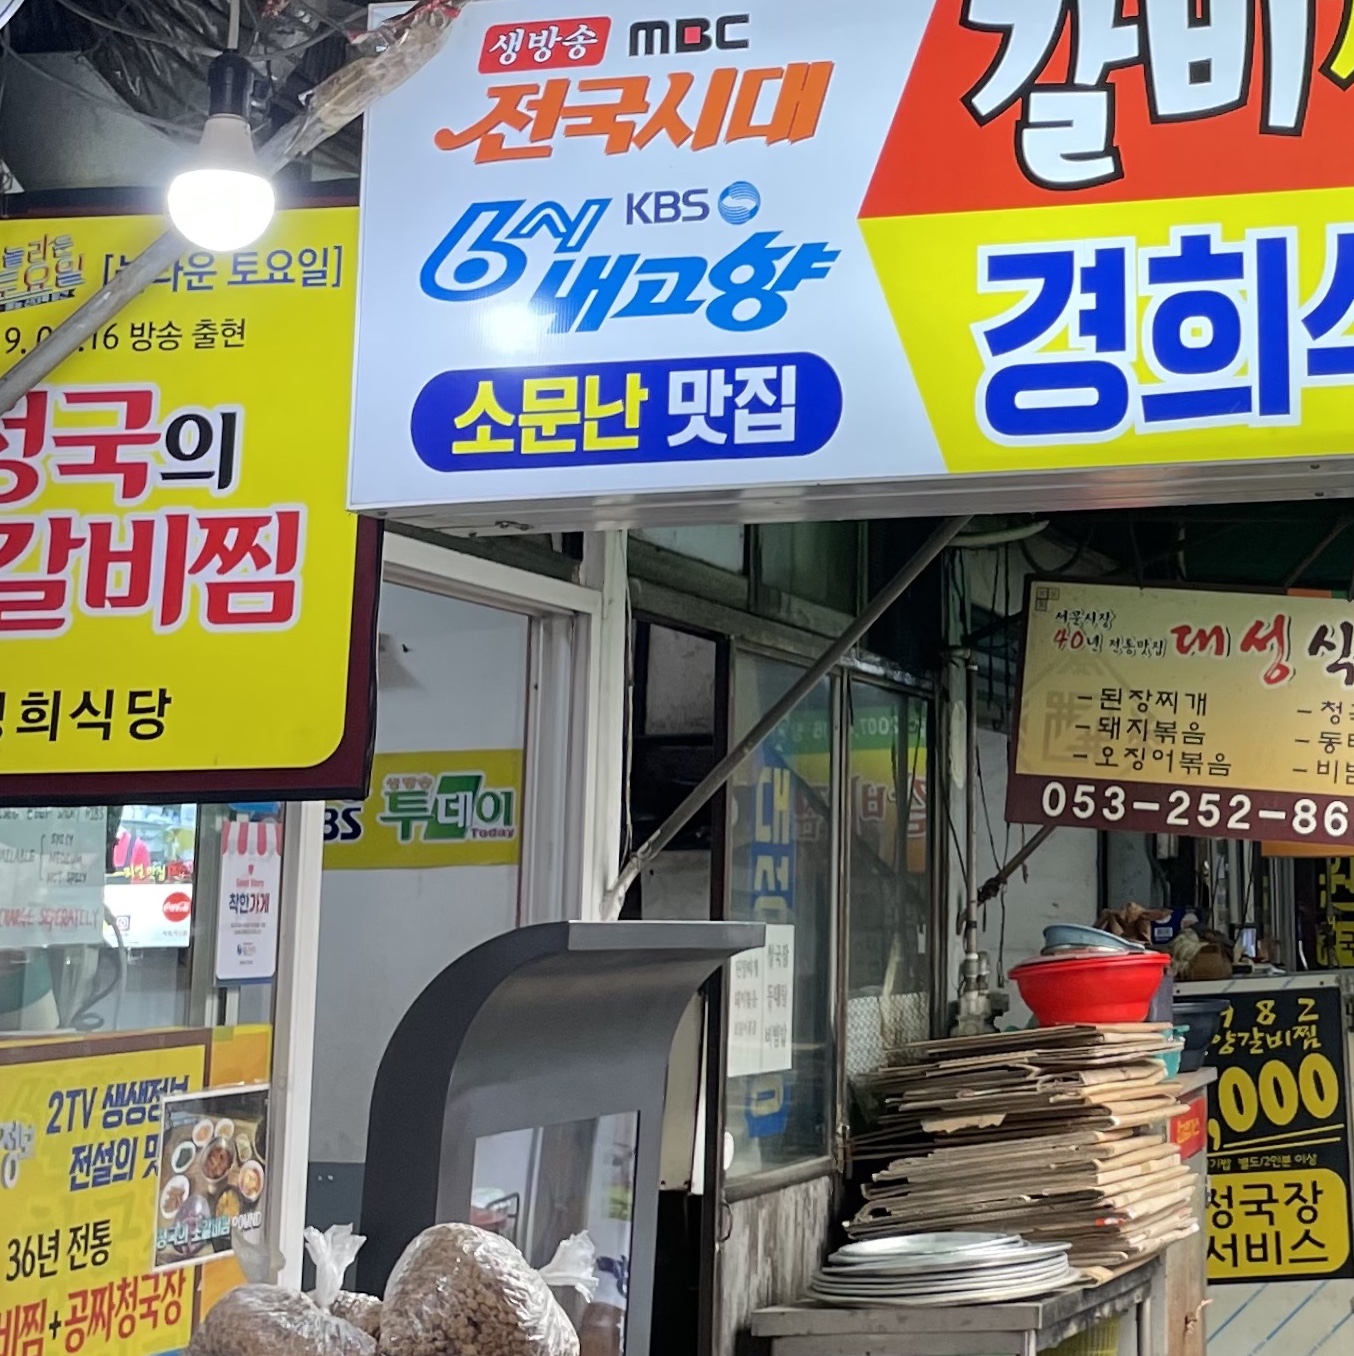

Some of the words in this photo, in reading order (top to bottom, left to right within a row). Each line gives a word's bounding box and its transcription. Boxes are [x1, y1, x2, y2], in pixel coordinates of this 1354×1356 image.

[486, 17, 601, 67] 생방송
[628, 13, 751, 58] MBC
[433, 59, 836, 166] 전국시대
[624, 187, 711, 227] KBS
[530, 228, 843, 334] 내고향
[130, 322, 182, 352] 방송
[192, 318, 246, 350] 출현
[450, 372, 648, 457] 소문난
[665, 364, 798, 448] 맛집
[1053, 627, 1103, 653] 40년
[2, 688, 172, 743] 희식당
[379, 790, 514, 841] 투데이
[471, 827, 515, 838] Today
[46, 1086, 98, 1135] 2TV
[69, 1136, 139, 1192] 전설의
[6, 1229, 61, 1281] 36년
[66, 1219, 113, 1271] 전통
[1205, 1229, 1329, 1268] 서비스
